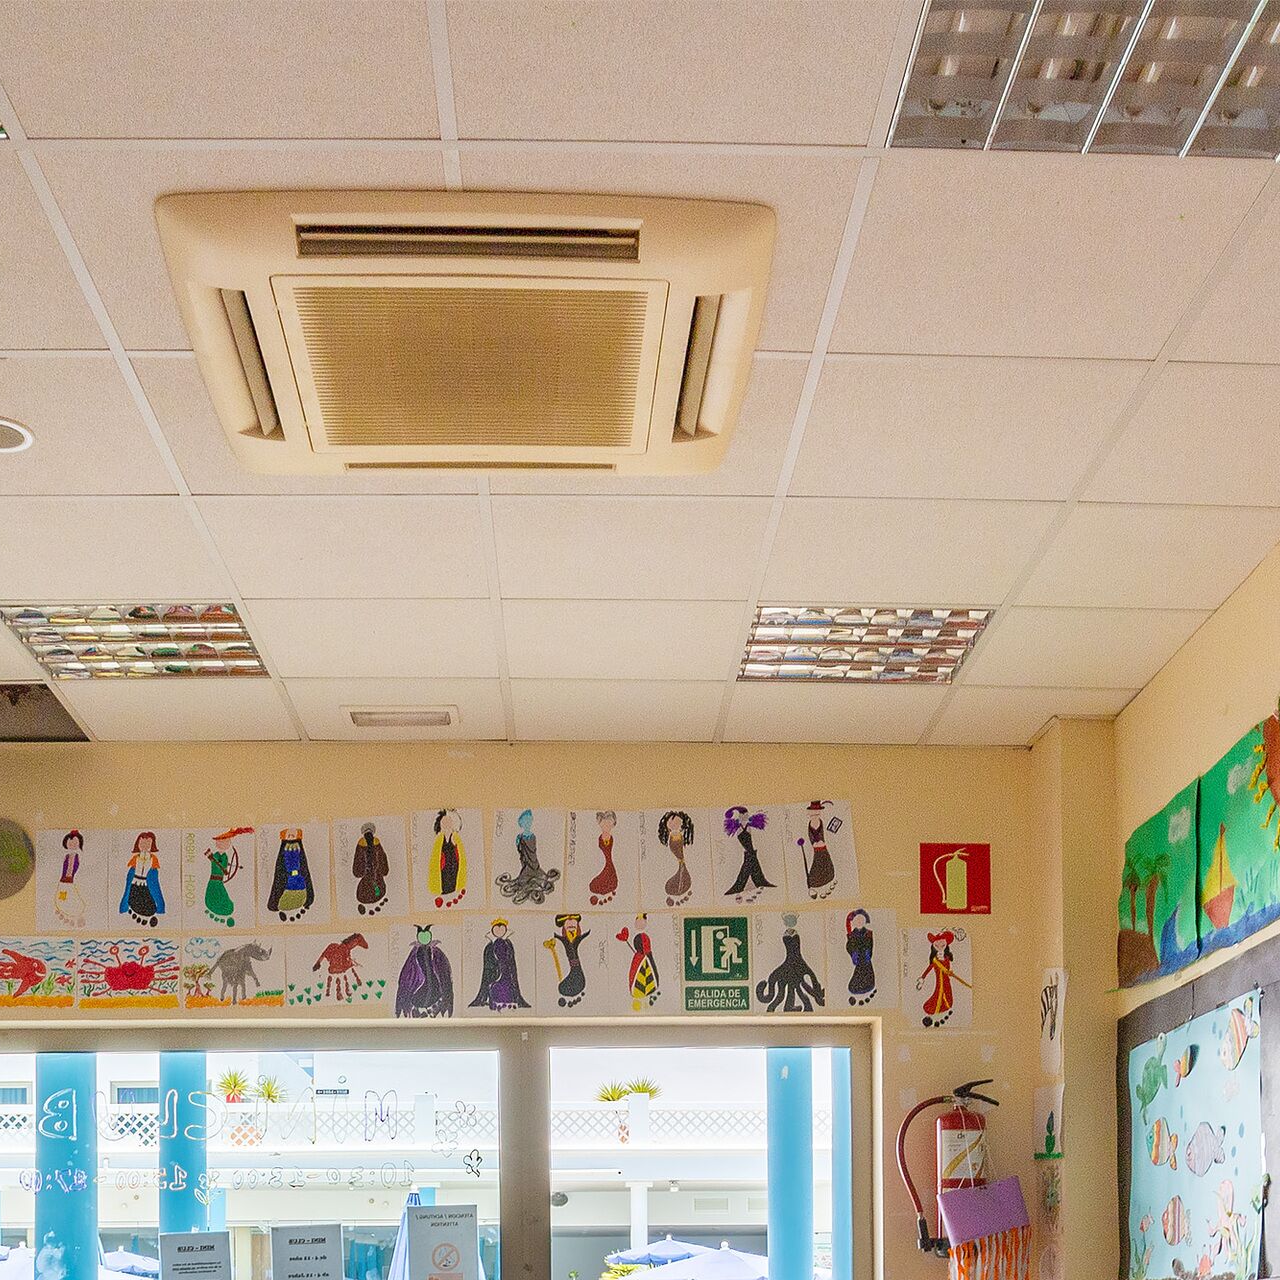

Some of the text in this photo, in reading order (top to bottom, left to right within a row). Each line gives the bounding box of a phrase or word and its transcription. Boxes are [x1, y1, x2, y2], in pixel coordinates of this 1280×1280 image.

[184, 832, 196, 909] ROBIN HOOD
[693, 988, 741, 999] SALIDA DE
[687, 997, 748, 1009] EMERGENCIA
